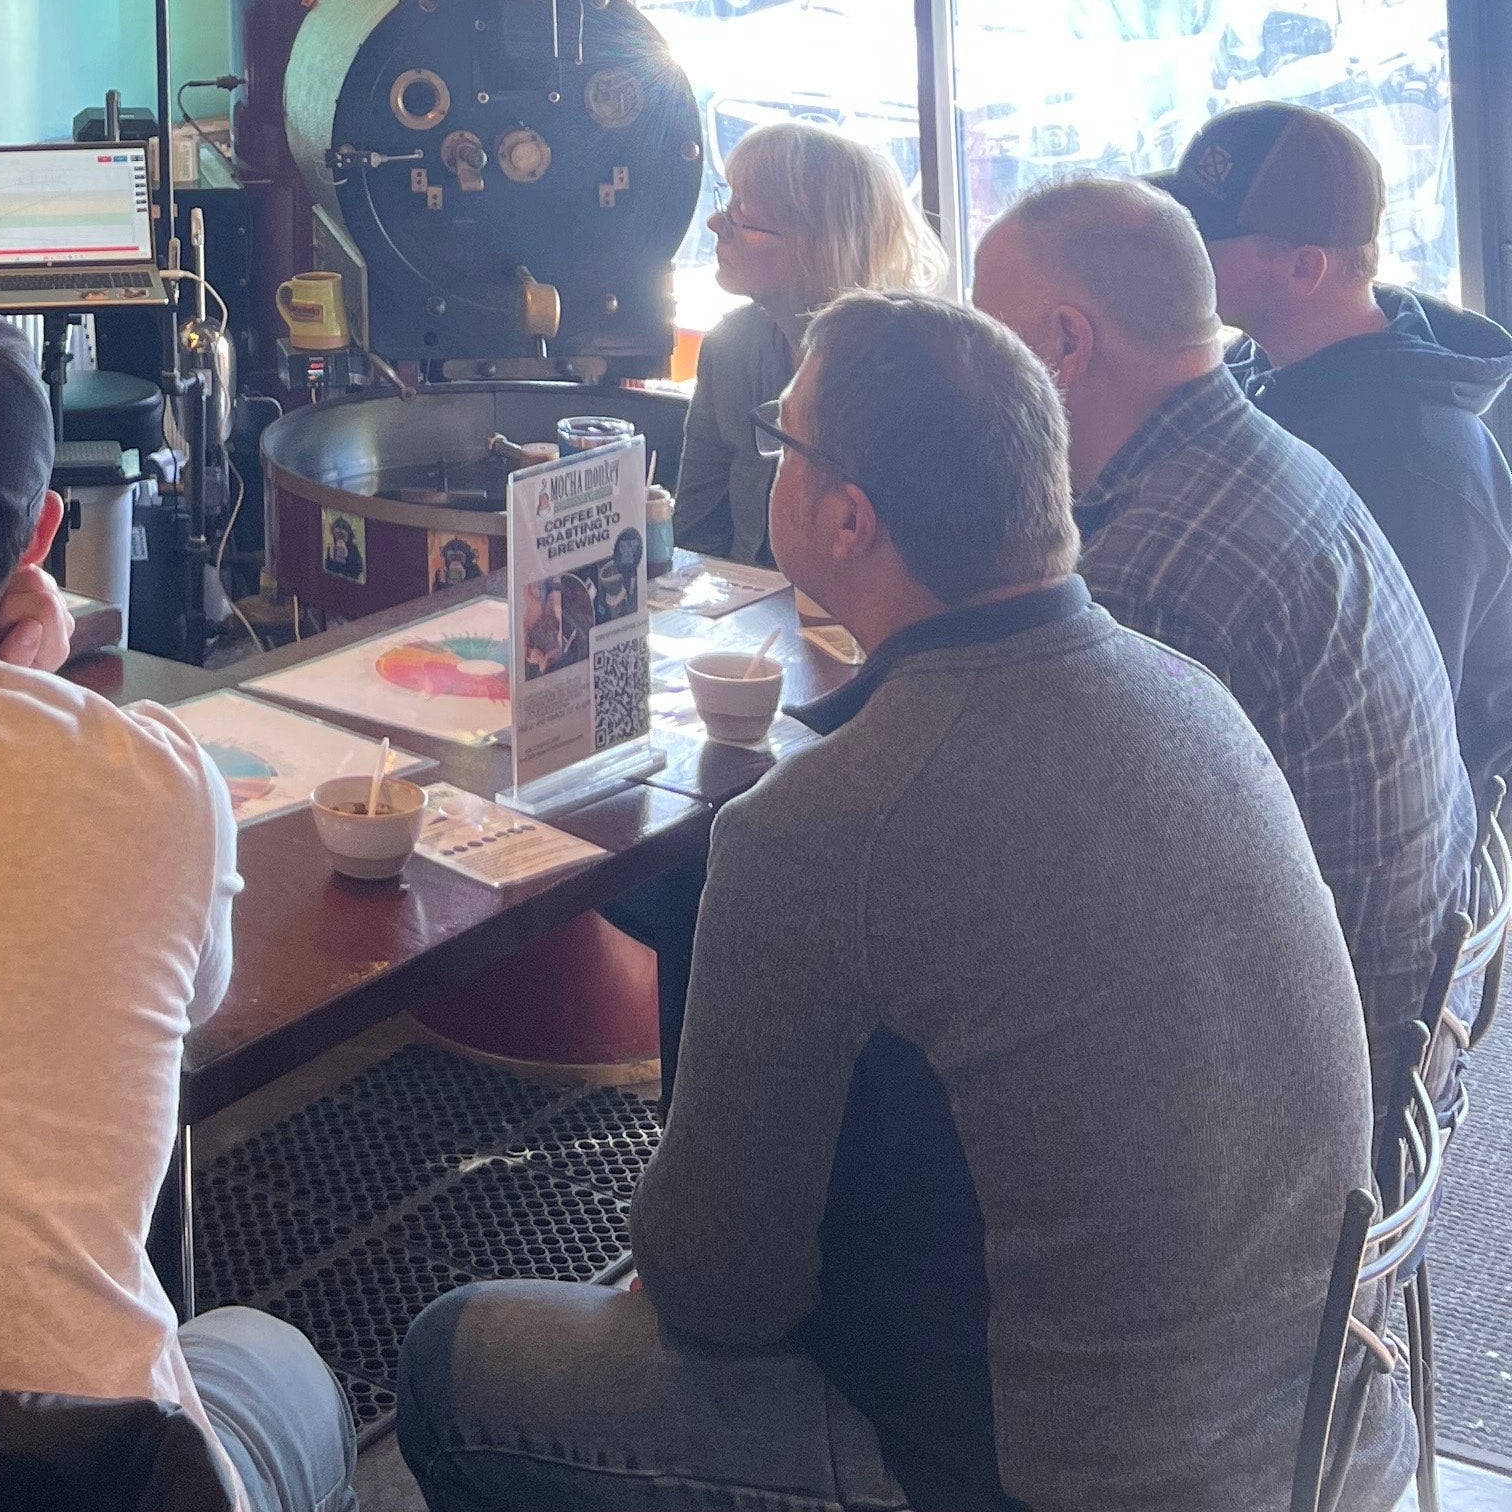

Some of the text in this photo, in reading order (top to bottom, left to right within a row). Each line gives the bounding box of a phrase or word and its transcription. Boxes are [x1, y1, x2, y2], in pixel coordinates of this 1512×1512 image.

[550, 469, 584, 501] MOCHA
[584, 460, 620, 490] monkey
[536, 511, 621, 550] ROASTING TO
[544, 501, 612, 533] COFFEE 101
[547, 529, 610, 559] BREWING
